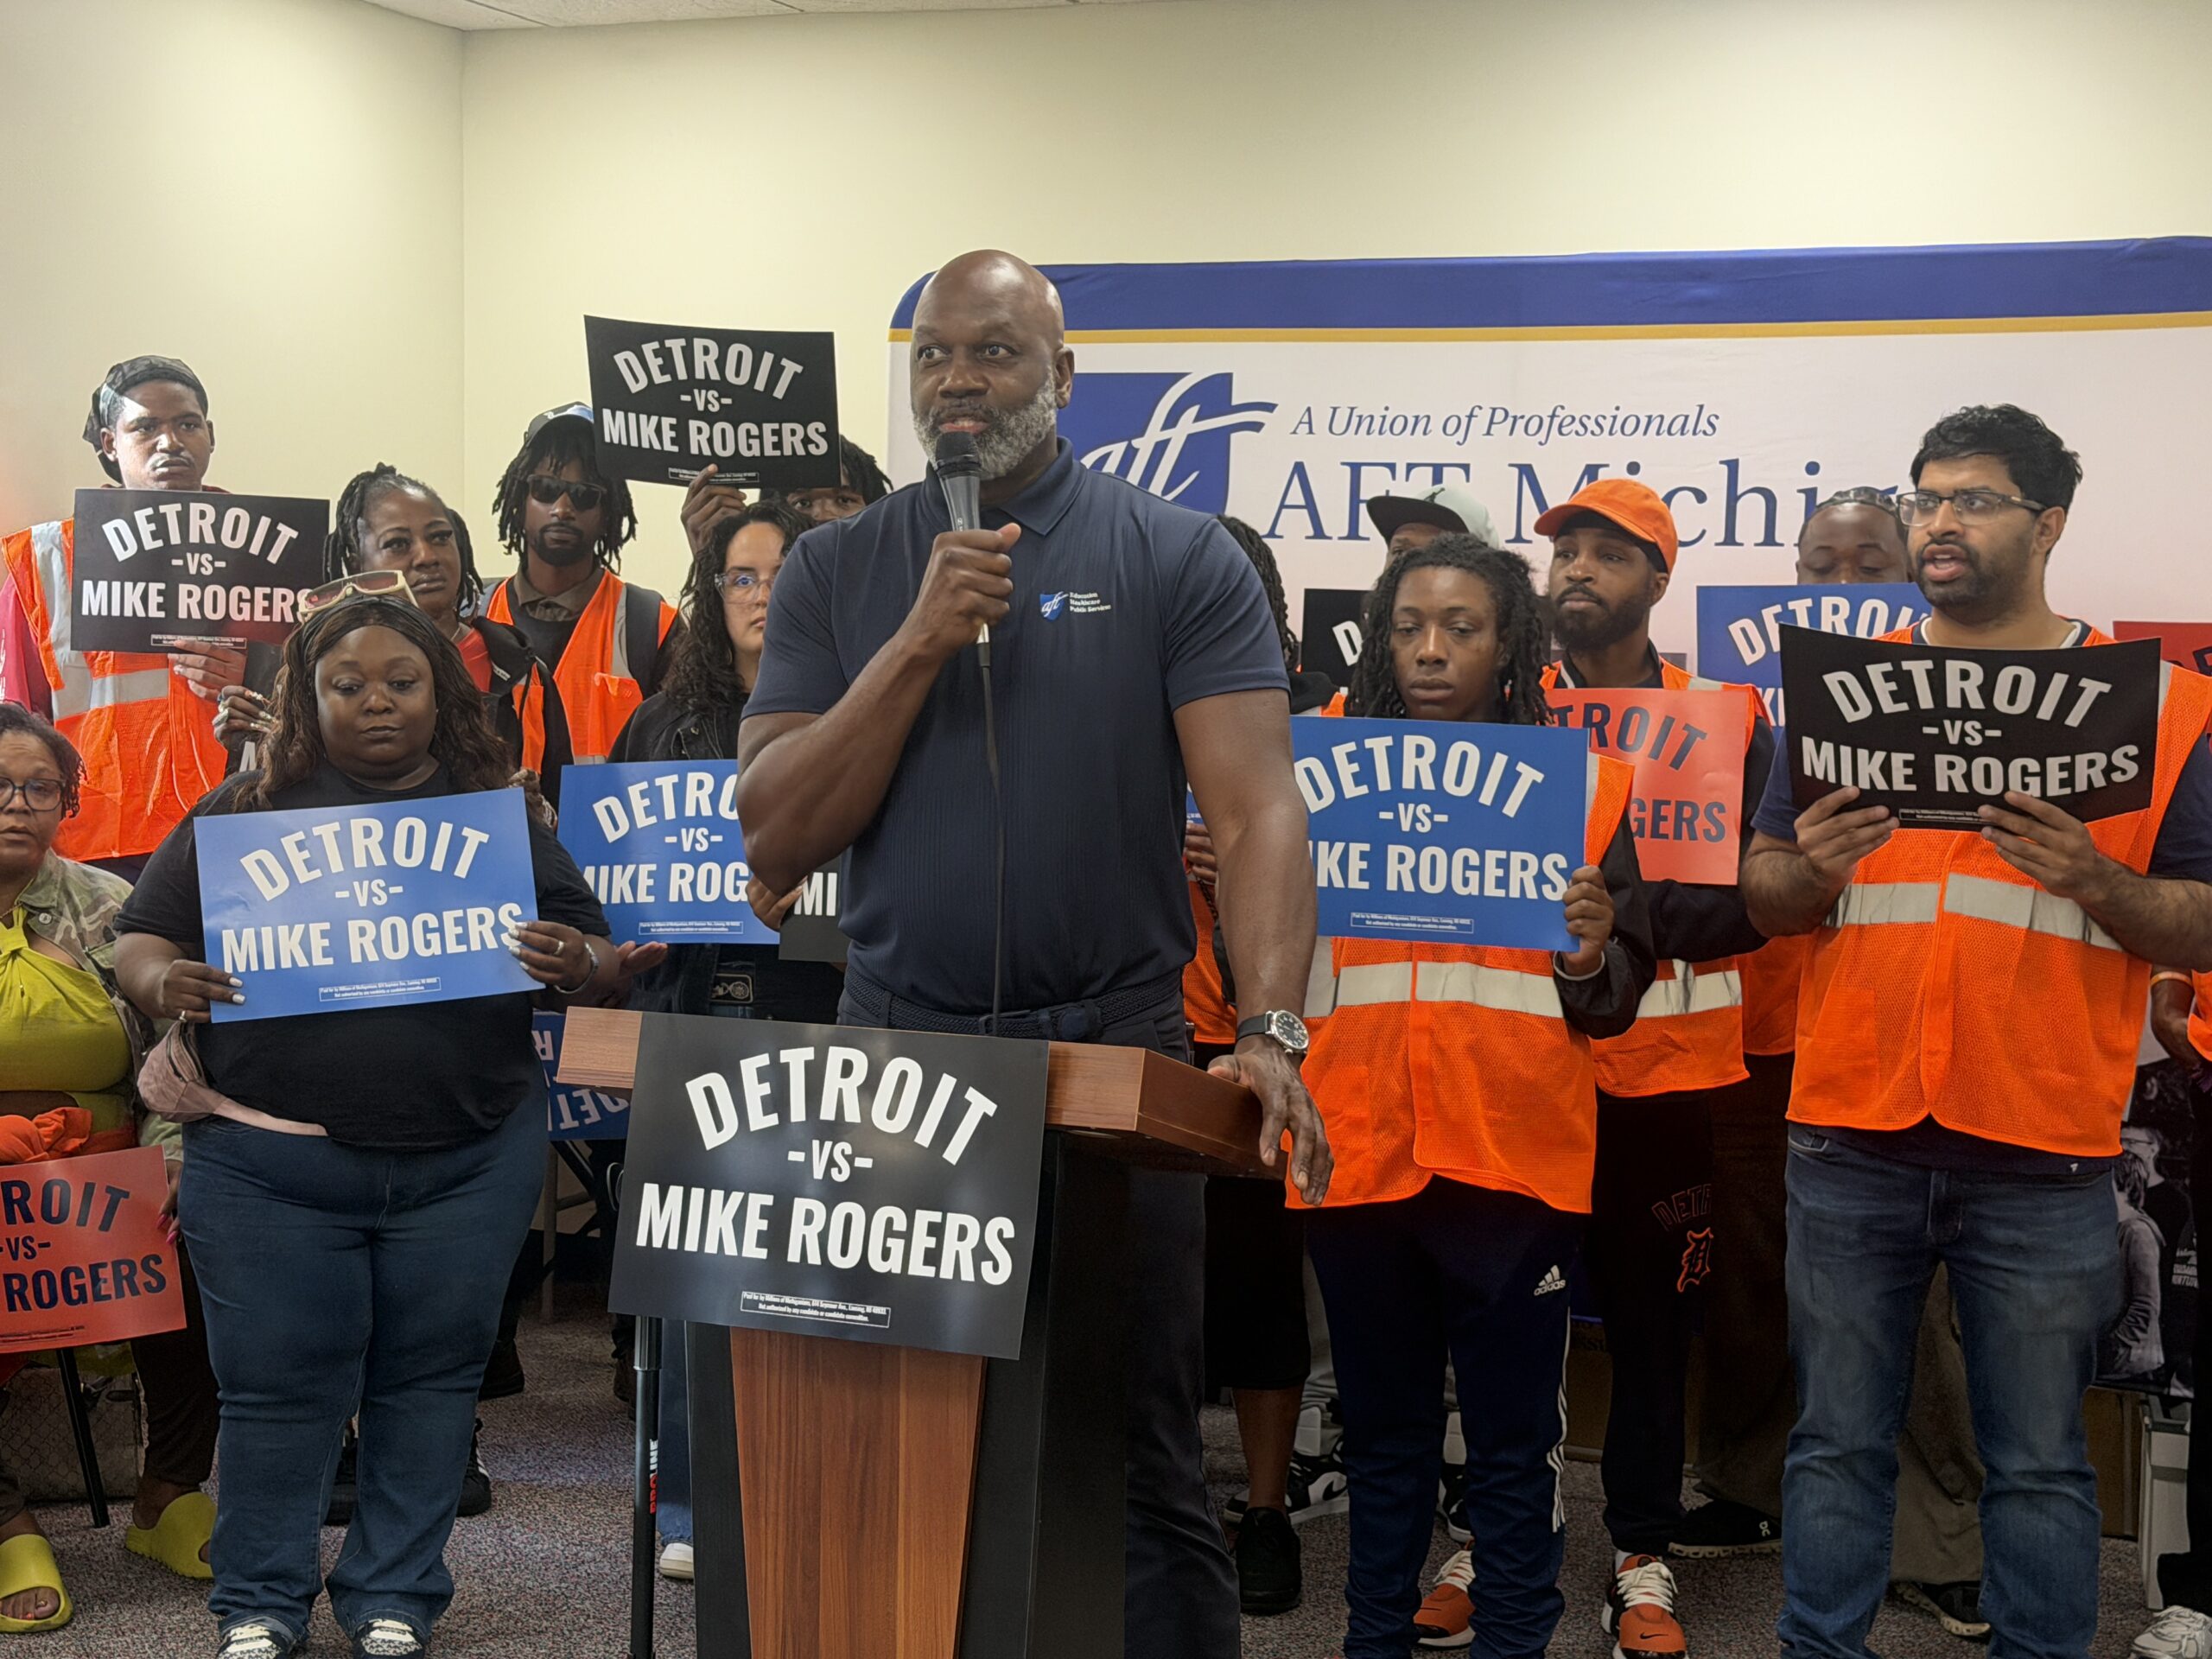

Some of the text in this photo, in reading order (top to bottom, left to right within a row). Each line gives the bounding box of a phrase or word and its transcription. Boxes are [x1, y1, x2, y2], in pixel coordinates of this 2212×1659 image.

[613, 338, 804, 399] DETROIT
[680, 389, 732, 412] -VS-
[1291, 404, 1719, 446] A Union of Professionals
[602, 408, 829, 457] MIKE ROGERS
[102, 502, 299, 564] DETROIT
[172, 552, 226, 575] -VS-
[82, 580, 166, 618] MIKE
[1822, 659, 2112, 728] DETROIT
[1551, 702, 1707, 771] TROIT
[1922, 719, 2002, 747] -VS-
[1294, 734, 1545, 818] DETROIT
[1802, 735, 2139, 797] MIKE ROGERS
[593, 772, 739, 842] DETRO
[1379, 803, 1449, 833] -VS-
[1630, 798, 1726, 842] GERS
[240, 817, 489, 901] DETROIT
[664, 828, 723, 852] -VS-
[335, 879, 404, 906] -VS-
[669, 862, 749, 903] ROG
[1386, 844, 1568, 901] ROGERS
[222, 903, 522, 973] MIKE ROGERS
[685, 1046, 998, 1166] DETROIT
[788, 1139, 873, 1182] -VS-
[0, 1179, 130, 1232] ROIT
[0, 1236, 51, 1262] VS-
[636, 1182, 1015, 1286] MIKE ROGERS
[3, 1254, 167, 1313] ROGERS
[1534, 1280, 1567, 1296] adidas
